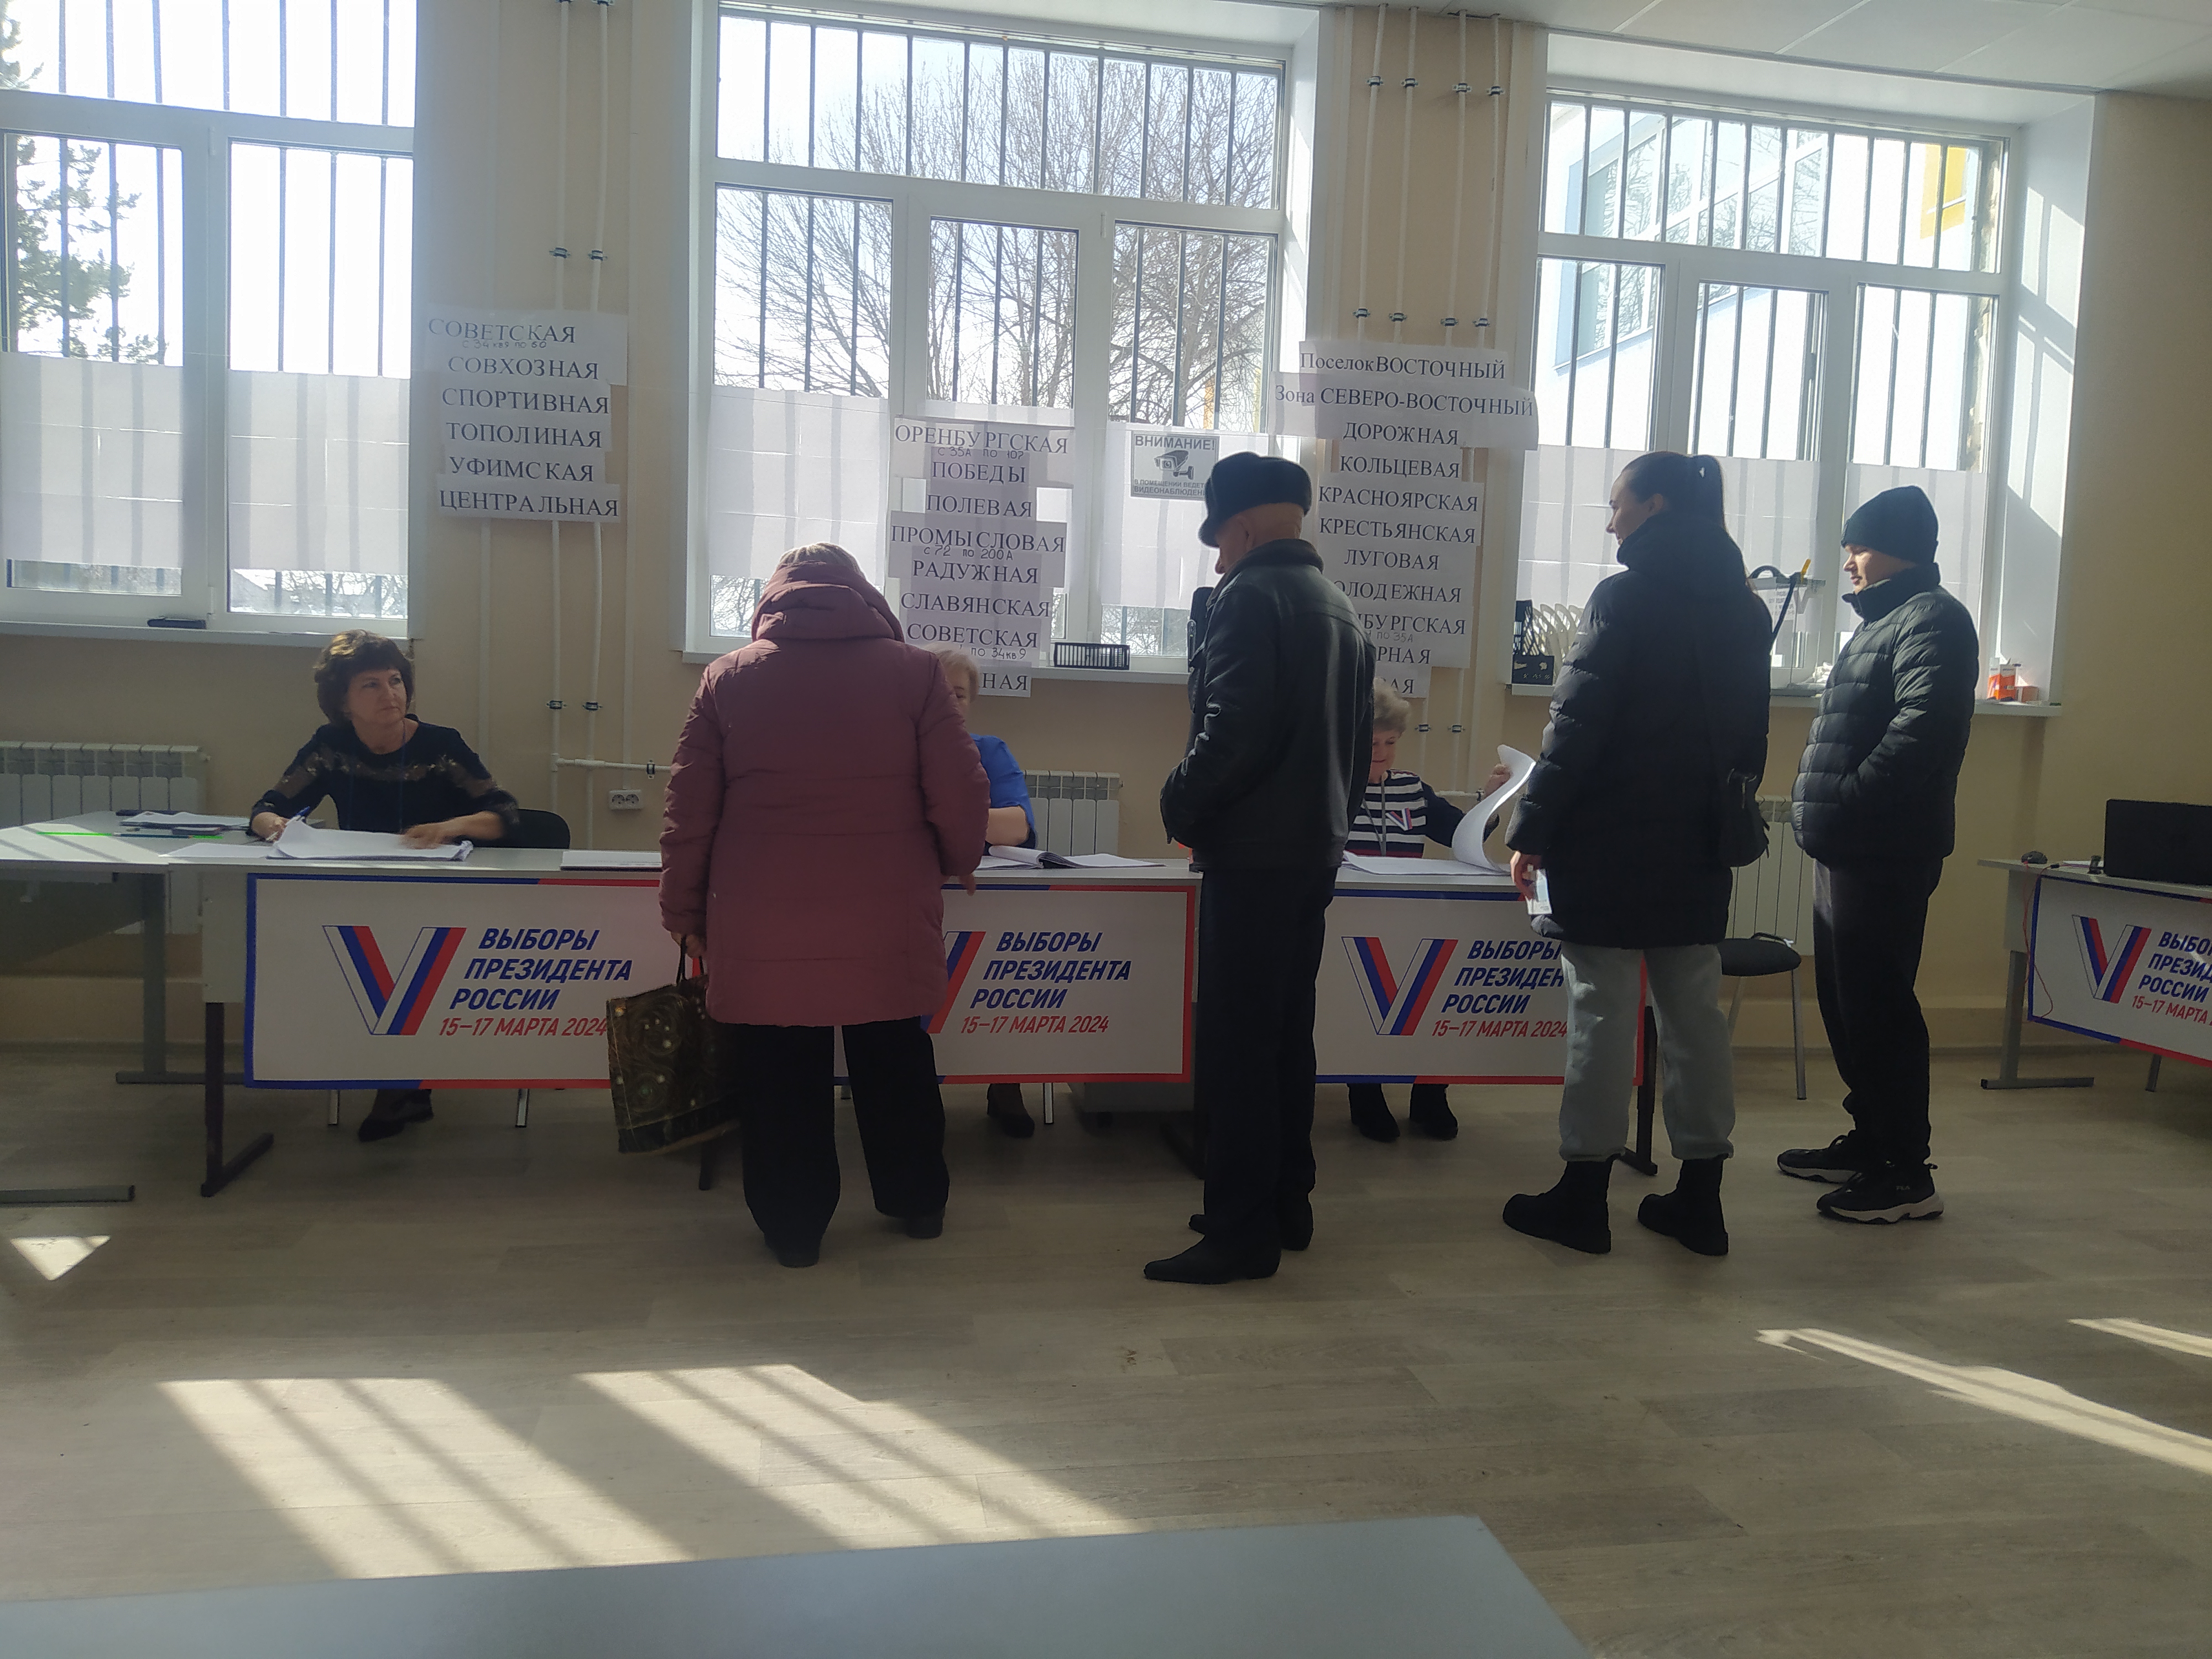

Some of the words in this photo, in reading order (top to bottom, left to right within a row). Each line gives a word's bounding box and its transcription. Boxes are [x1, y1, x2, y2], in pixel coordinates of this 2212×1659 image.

[429, 319, 575, 343] СОВЕТСКАЯ
[474, 339, 489, 348] 34
[448, 356, 599, 380] СОВХОЗНАЯ
[442, 388, 609, 414] СПОРТИВНАЯ
[1275, 385, 1315, 404] Зона
[1320, 387, 1533, 417] СЕВЕРО-ВОСТОЧНЫЙ
[446, 422, 602, 448] ТОПОЛИНАЯ
[895, 425, 1068, 454] ОРЕНБУРГСКАЯ
[1135, 435, 1215, 450] ВНИМАНИЕ!
[1343, 422, 1459, 446] ДОРОЖНАЯ
[1007, 450, 1024, 460] 107
[449, 456, 593, 482] УФИМСКАЯ
[932, 461, 1025, 484] ПОБЕДЫ
[1340, 456, 1460, 479] КОЛЬЦЕВАЯ
[1134, 486, 1207, 496] ВИДЕОНАБЛЮДЕН
[1318, 486, 1479, 512] КРАСНОЯРСКАЯ
[440, 490, 619, 517] ЦЕНТРАЛЬНАЯ
[927, 494, 1032, 518] ПОЛЕВАЯ
[891, 525, 1065, 553] ПРОМЫСЛОВАЯ
[1319, 518, 1475, 544] КРЕСТЬЯНСКАЯ
[935, 545, 951, 557] 72
[1344, 549, 1439, 570] ЛУГОВАЯ
[913, 560, 1039, 584] РАДУЖНАЯ
[1333, 580, 1462, 603] ОЛОДЕЖНАЯ
[901, 593, 1050, 617] СЛАВЯНСКАЯ
[907, 623, 1037, 648] СОВЕТСКАЯ
[1358, 613, 1465, 635] БУРГСКАЯ
[478, 928, 600, 951] ВЫБОРЫ
[996, 931, 1103, 952] ВЫБОРЫ
[1467, 940, 1562, 961] ВЫБОРЫ
[2158, 931, 2212, 956] ВЫБО
[464, 958, 632, 983] ПРЕЗИДЕНТА
[983, 960, 1132, 984] ПРЕЗИДЕНТА
[1454, 967, 1564, 990] ПРЕЗИДЕН
[2148, 953, 2212, 984] ПРЕЗИД
[449, 988, 560, 1010] РОССИИ
[970, 988, 1068, 1009] РОССИИ
[2138, 974, 2210, 1003] РОССИИ
[1441, 994, 1531, 1014] РОССИИ
[2165, 1002, 2208, 1024] МАРТА
[495, 1018, 560, 1036] МАРТА
[561, 1018, 607, 1036] 2024
[1009, 1015, 1067, 1034] МАРТА
[1068, 1015, 1109, 1033] 2024
[1477, 1021, 1530, 1037] МАРТА
[1531, 1021, 1568, 1037] 2024
